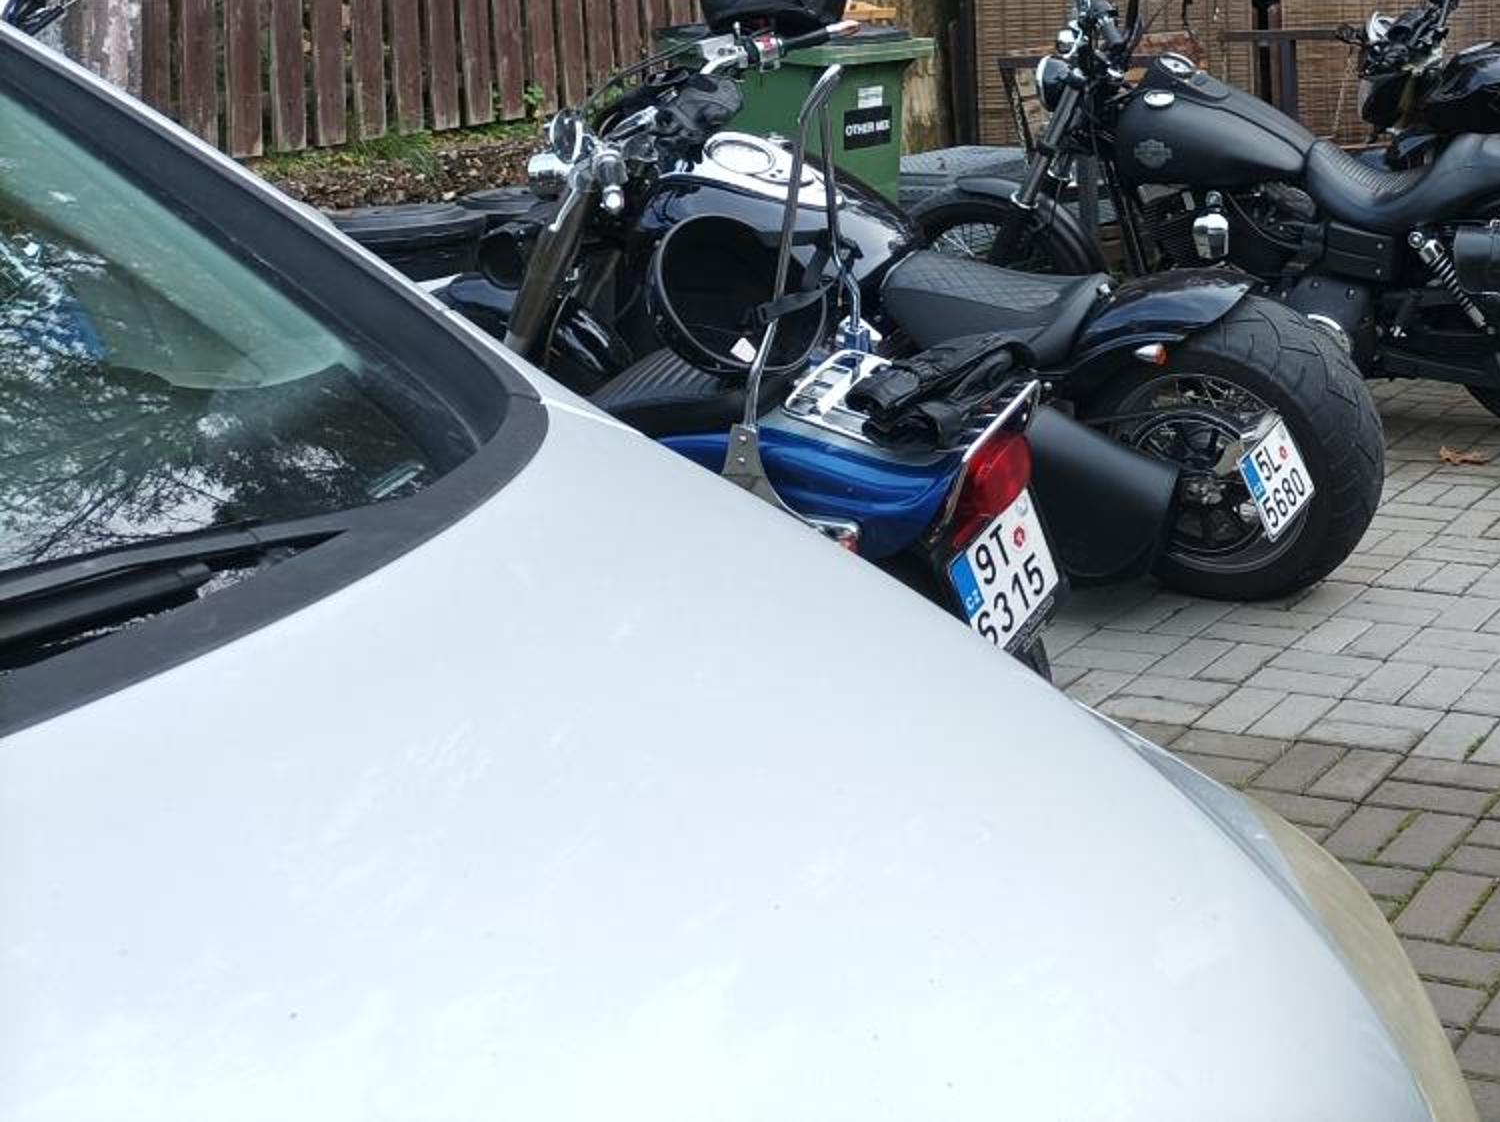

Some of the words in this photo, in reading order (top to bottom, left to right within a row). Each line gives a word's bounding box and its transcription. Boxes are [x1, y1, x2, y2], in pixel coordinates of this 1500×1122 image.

[845, 121, 875, 136] OTHER
[1255, 445, 1282, 481] 5L
[1262, 467, 1305, 528] 5680
[975, 523, 1010, 585] 9T
[965, 591, 981, 611] CZ
